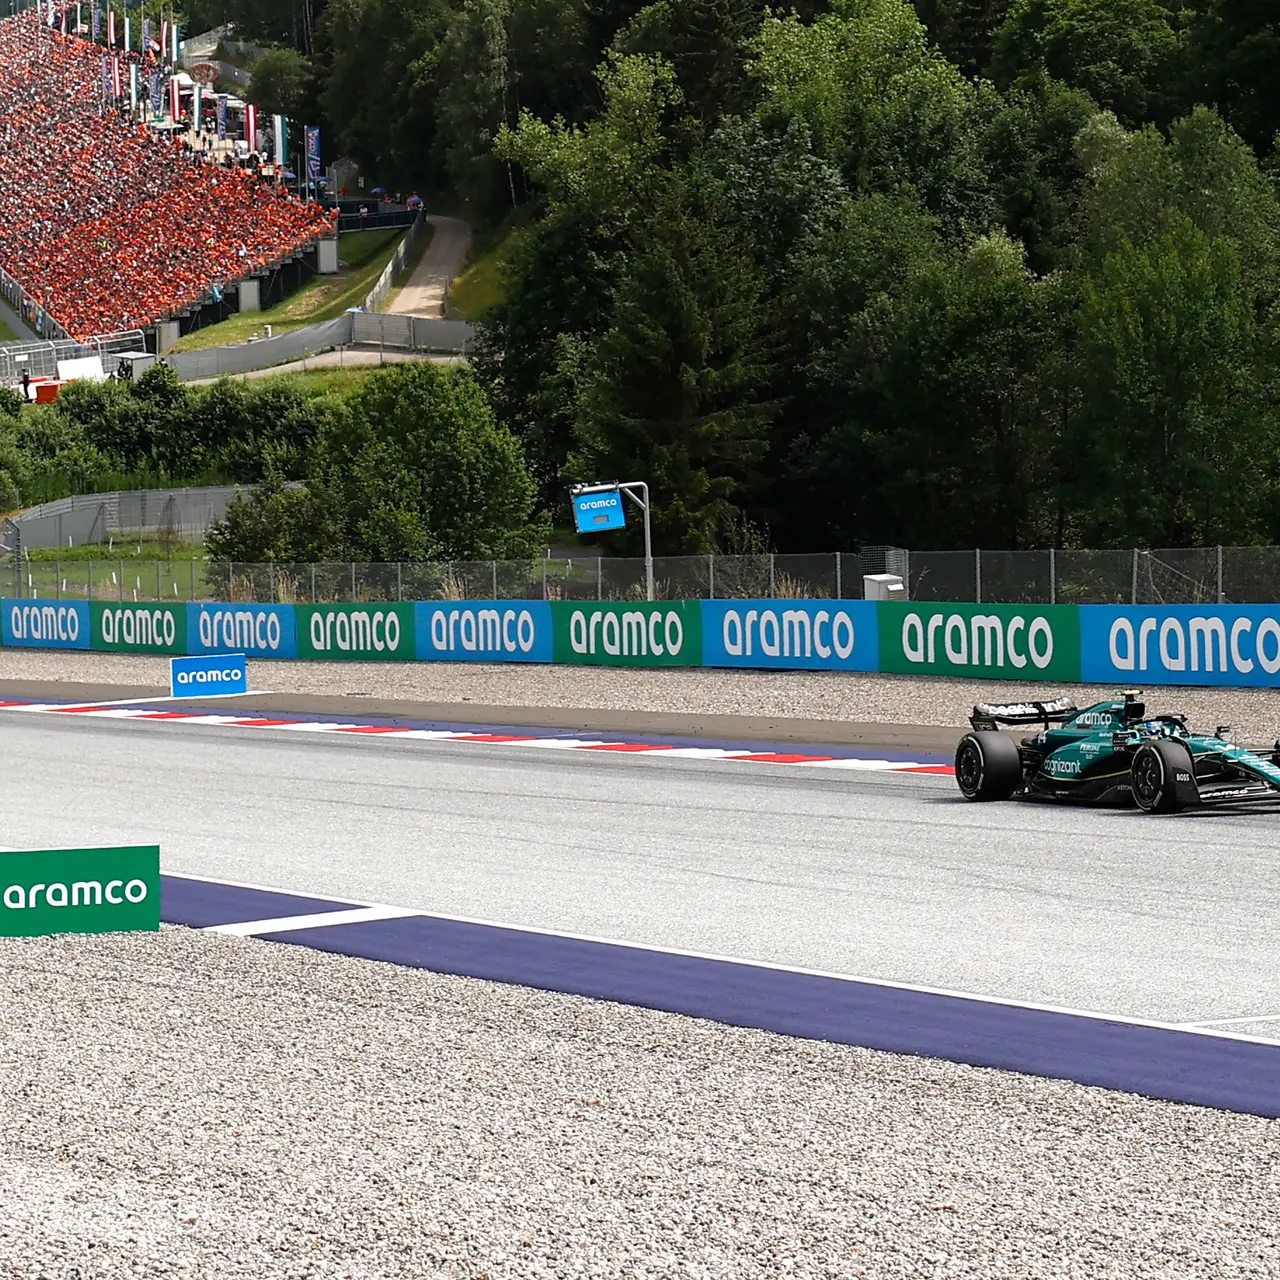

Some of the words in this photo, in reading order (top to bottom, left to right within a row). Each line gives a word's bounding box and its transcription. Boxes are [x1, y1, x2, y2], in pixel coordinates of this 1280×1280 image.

[580, 498, 617, 510] aramco
[11, 605, 79, 641] aramco
[101, 608, 176, 646] aramco
[199, 610, 281, 650] aramco
[310, 611, 400, 652] aramco
[431, 609, 535, 653] aramco
[569, 610, 683, 656] aramco
[723, 609, 855, 660] aramco
[902, 612, 1054, 669] aramco
[177, 668, 242, 684] aramco
[1075, 712, 1112, 725] aramco
[1043, 758, 1082, 776] cognizant
[1176, 773, 1190, 782] BOSS
[1199, 789, 1248, 799] aramco
[3, 879, 148, 909] aramco
